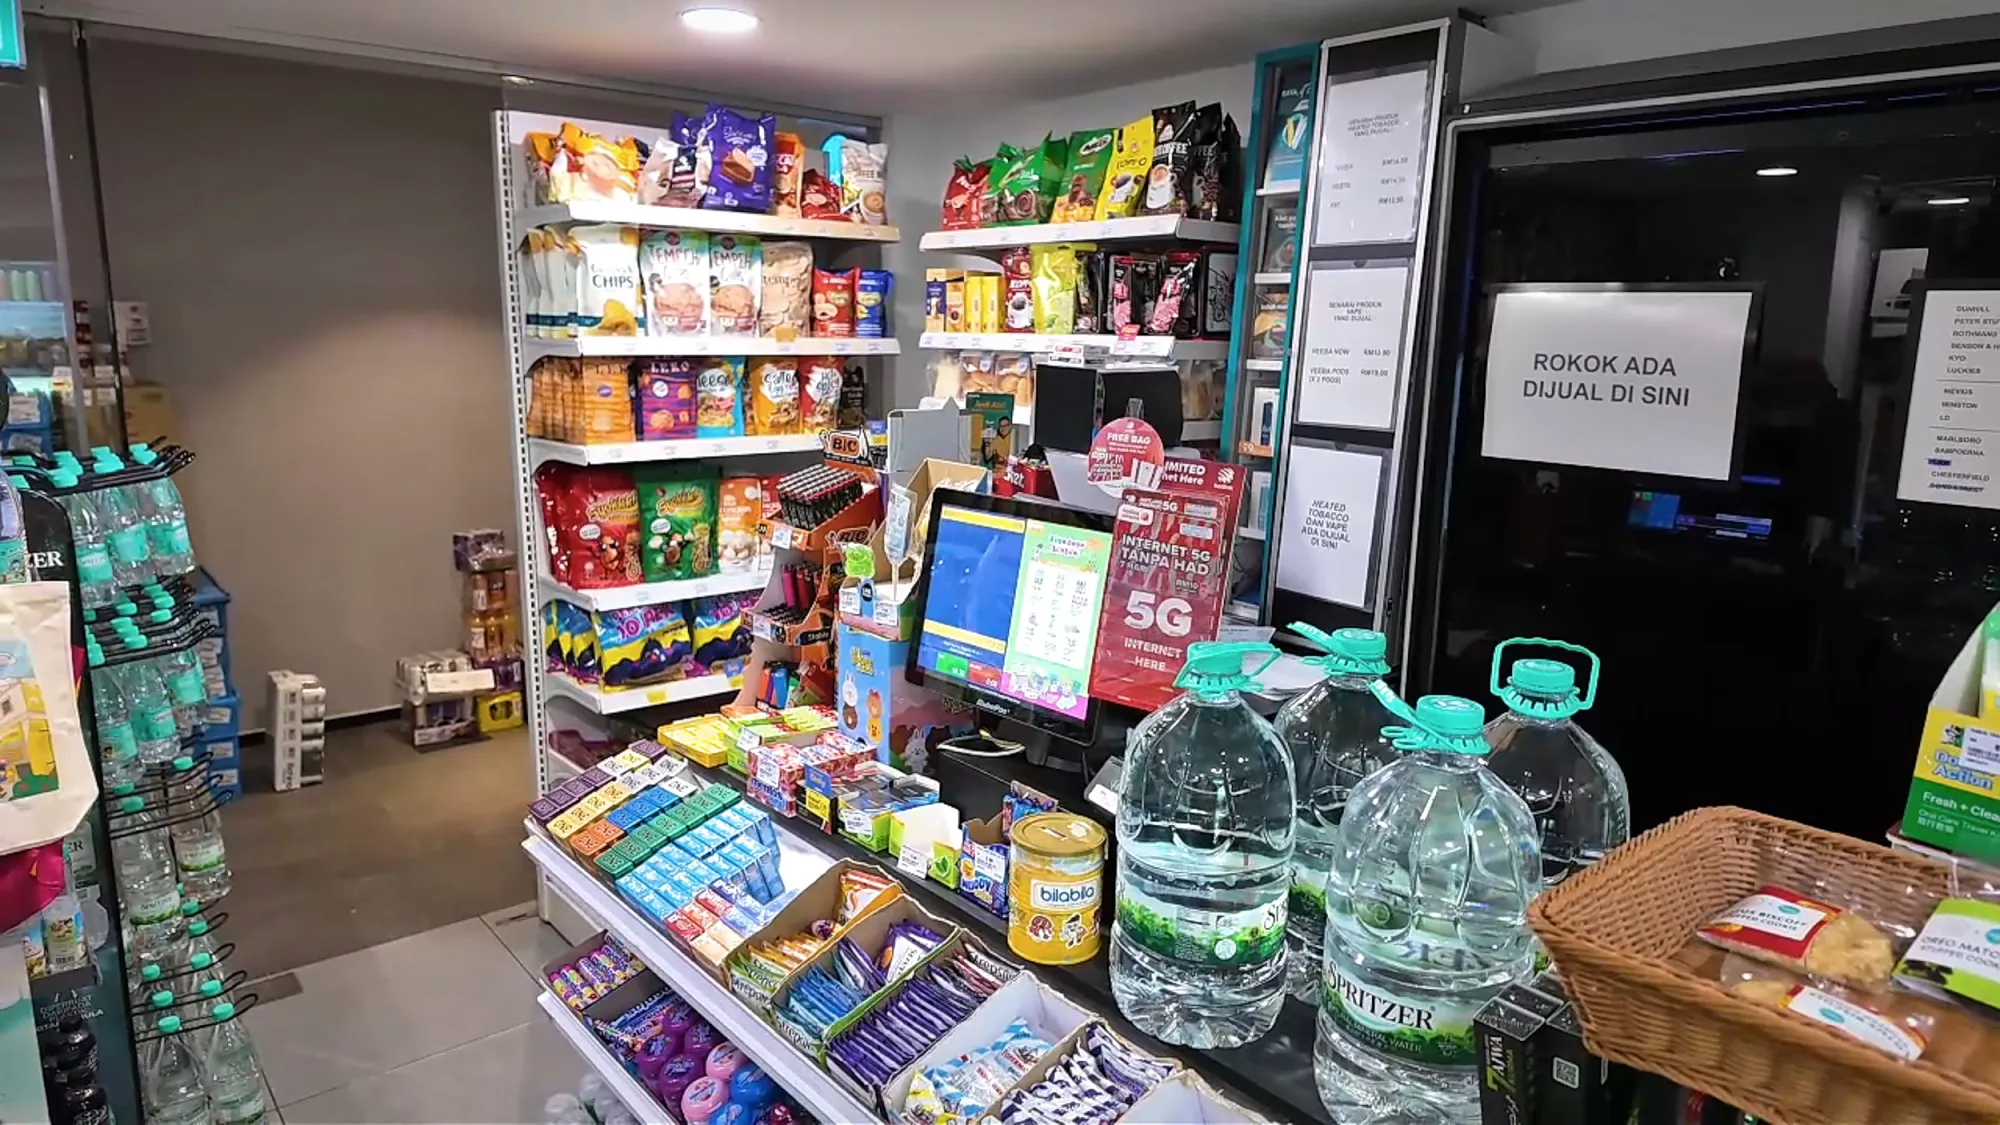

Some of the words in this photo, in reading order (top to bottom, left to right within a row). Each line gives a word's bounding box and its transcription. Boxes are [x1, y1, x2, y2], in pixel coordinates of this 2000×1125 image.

[592, 275, 634, 289] CHIPS
[1533, 353, 1618, 374] ROKOK
[1623, 356, 1677, 376] ADA
[1523, 380, 1603, 401] DIJUAL
[1610, 384, 1634, 403] DI
[1641, 386, 1690, 407] SINI
[833, 438, 857, 452] BIC
[1107, 433, 1130, 444] FREE
[1131, 434, 1151, 444] BAG
[1937, 435, 1982, 444] MARLBORO
[1934, 447, 1985, 456] SAMPOERNA
[1179, 473, 1204, 486] Here
[1931, 471, 1990, 482] CHESTERFIELD
[1163, 500, 1178, 512] 5G
[1312, 500, 1346, 512] HEATED
[1309, 508, 1349, 522] TOBACCO
[1301, 526, 1319, 536] ADA
[1326, 520, 1348, 532] VAPE
[1122, 534, 1188, 558] INTERNET
[1191, 549, 1211, 562] 5G
[1122, 547, 1170, 568] TANPA
[1174, 559, 1209, 576] HAD
[1124, 590, 1192, 637] 5G
[1124, 638, 1183, 658] INTERNET
[1135, 656, 1166, 671] HERE
[1932, 762, 1993, 790] Action
[1923, 791, 1957, 810] Fresh
[1759, 912, 1808, 926] BISCOFF
[1761, 920, 1798, 931] COOKIE
[1921, 936, 1956, 947] OREO
[1328, 960, 1434, 1030] SPRITZER
[1389, 1038, 1422, 1054] WATER
